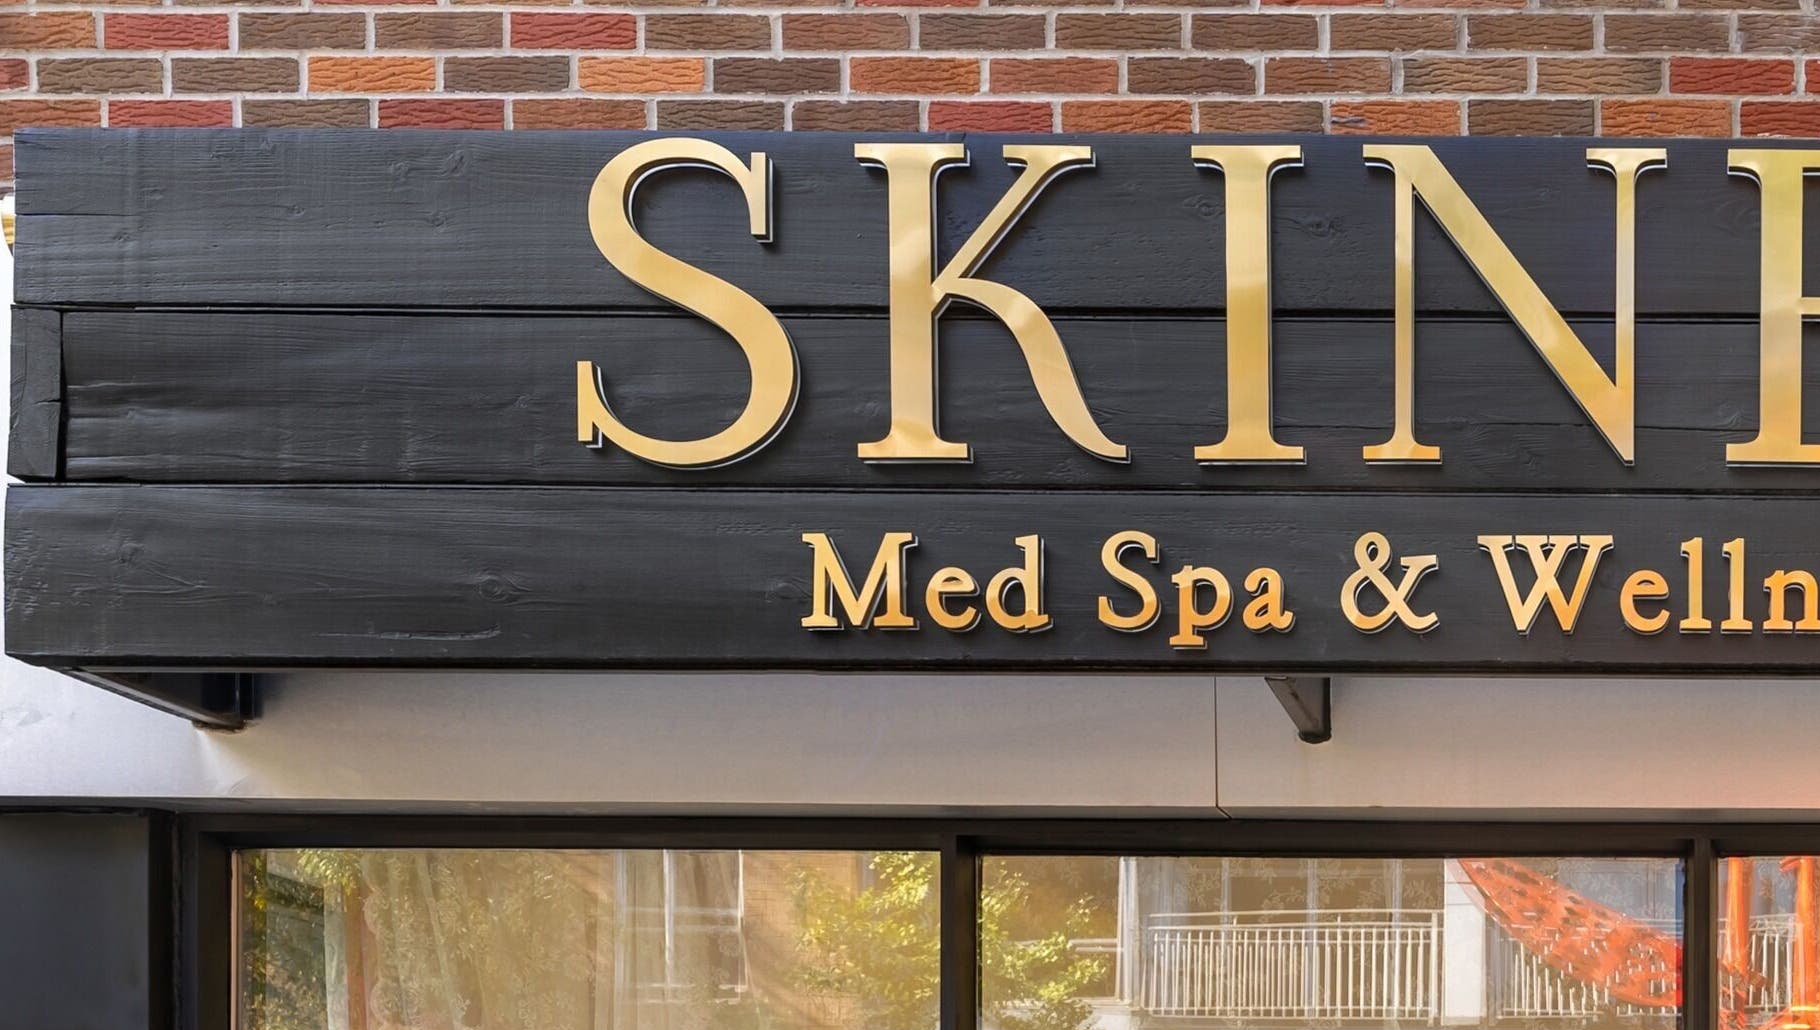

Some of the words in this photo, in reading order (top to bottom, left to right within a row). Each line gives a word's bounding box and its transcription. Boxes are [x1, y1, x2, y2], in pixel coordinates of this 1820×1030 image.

[801, 531, 1053, 632] Med
[1098, 530, 1295, 650] Spa
[1340, 531, 1441, 635] &
